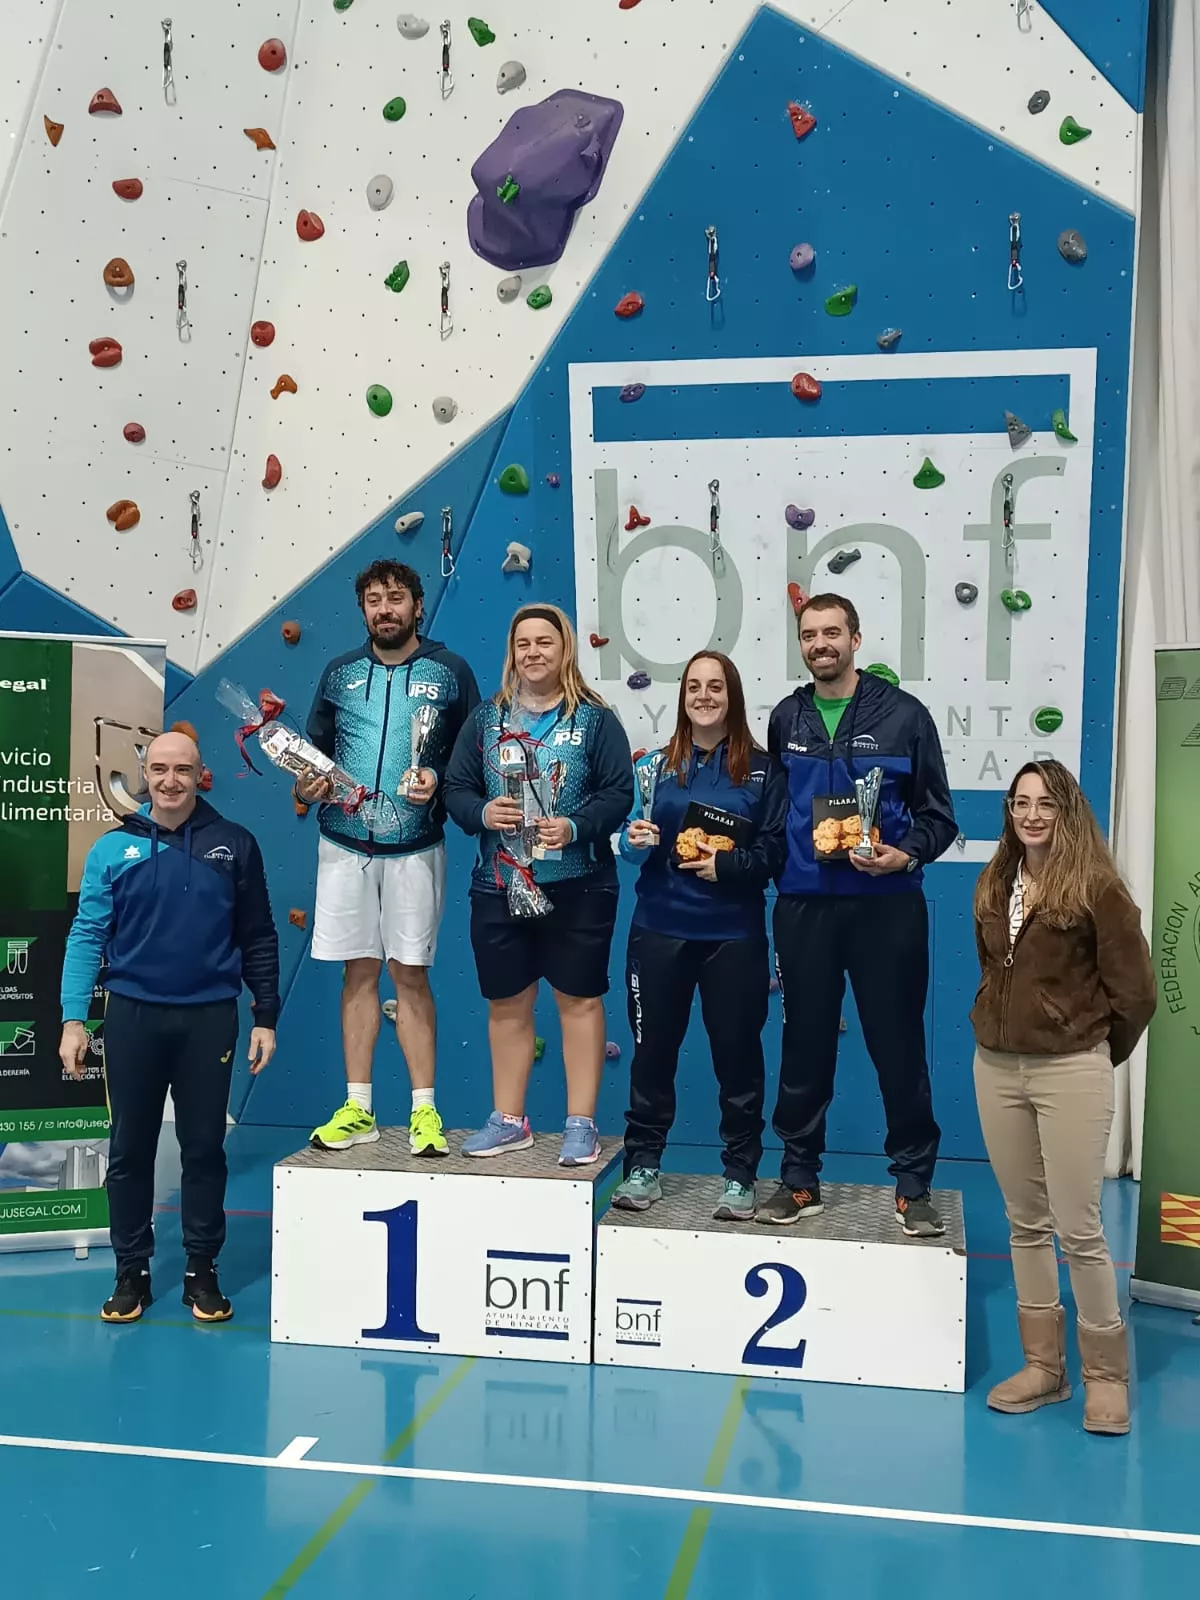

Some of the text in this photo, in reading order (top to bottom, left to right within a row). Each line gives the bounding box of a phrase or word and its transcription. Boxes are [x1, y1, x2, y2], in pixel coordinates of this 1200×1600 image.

[594, 456, 1067, 684] bnf
[0, 747, 51, 766] vicio
[0, 775, 95, 794] ndustria
[1, 802, 114, 822] limentaria
[828, 797, 857, 806] PILARA
[361, 1200, 440, 1344] 1
[485, 1264, 570, 1312] bnf
[616, 1305, 661, 1332] bnf
[742, 1262, 807, 1369] 2
